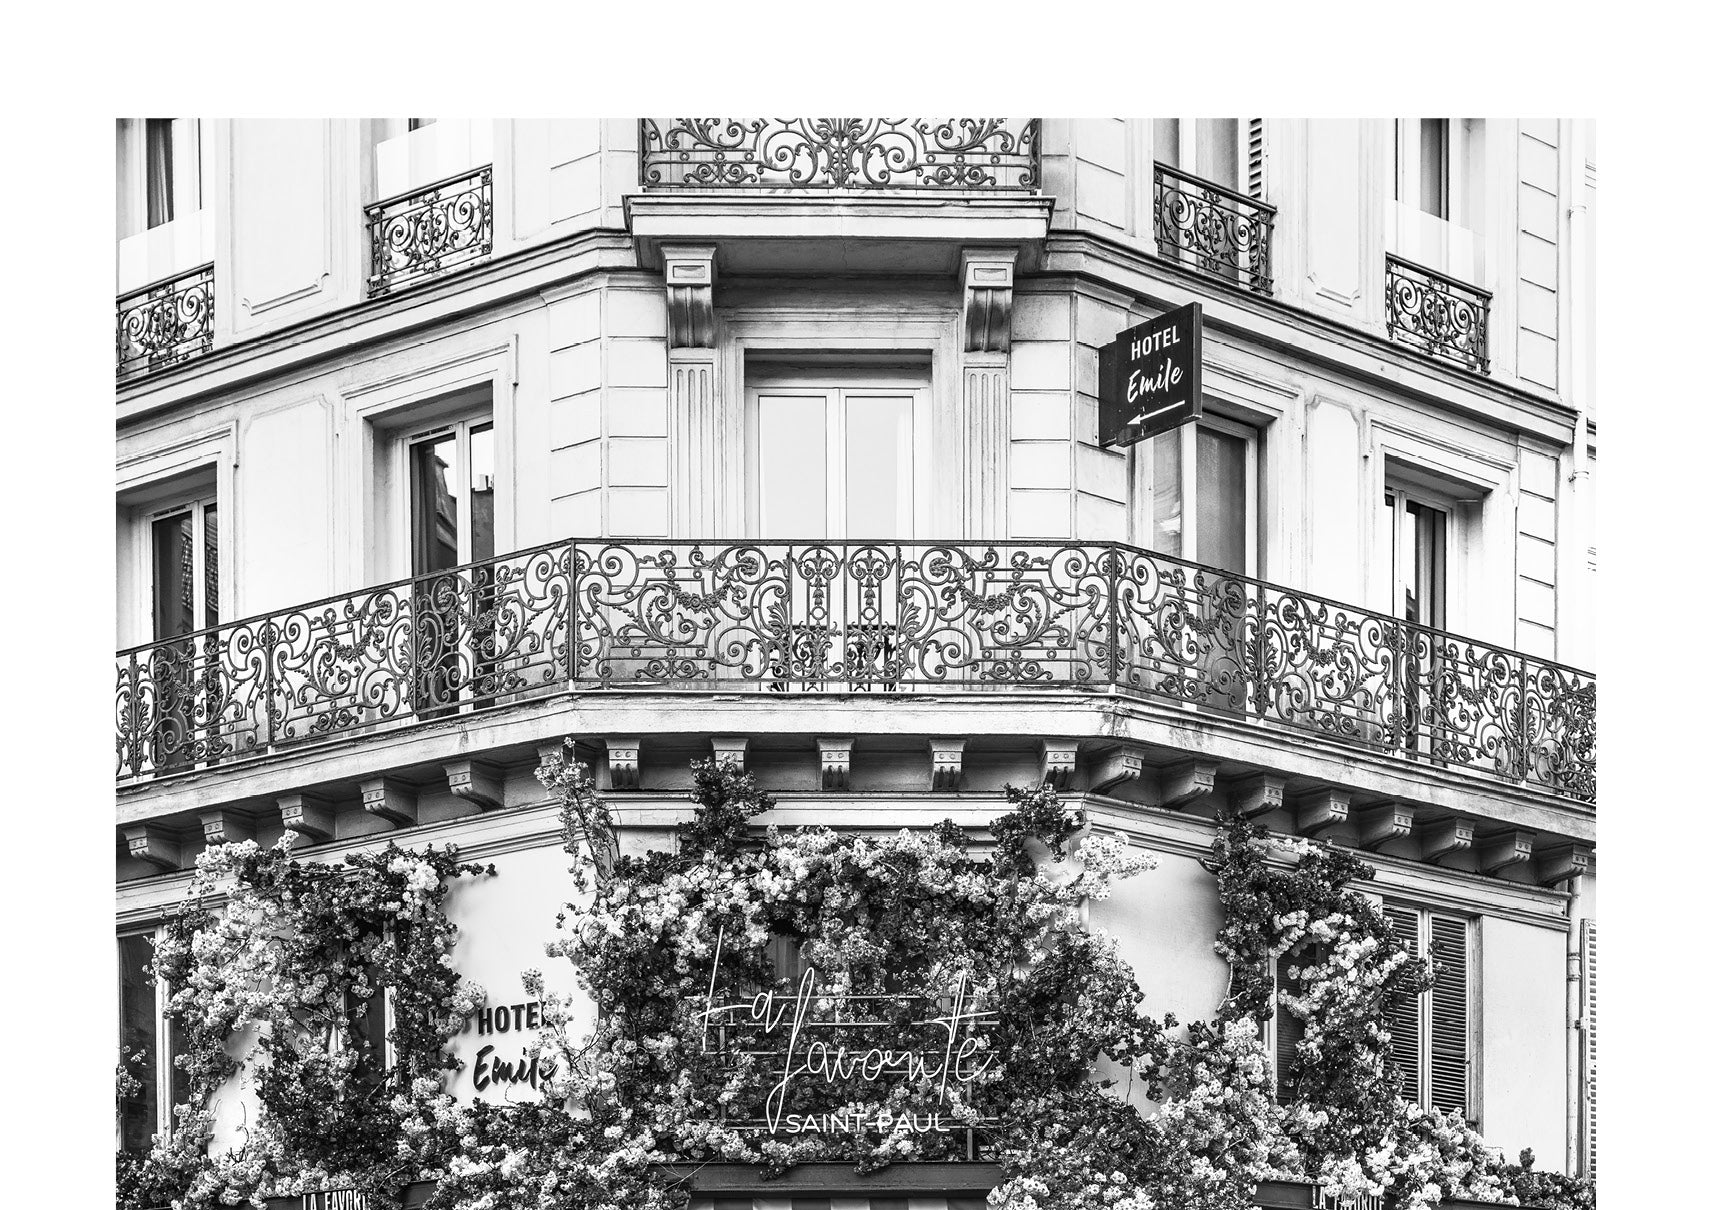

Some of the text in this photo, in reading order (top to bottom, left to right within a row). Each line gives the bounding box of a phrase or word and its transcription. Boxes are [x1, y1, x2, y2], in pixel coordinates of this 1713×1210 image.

[1131, 325, 1181, 361] HOTEL
[1127, 357, 1184, 403] Emile
[785, 1113, 951, 1134] SAINT-PAUL
[1312, 1185, 1326, 1210] LA
